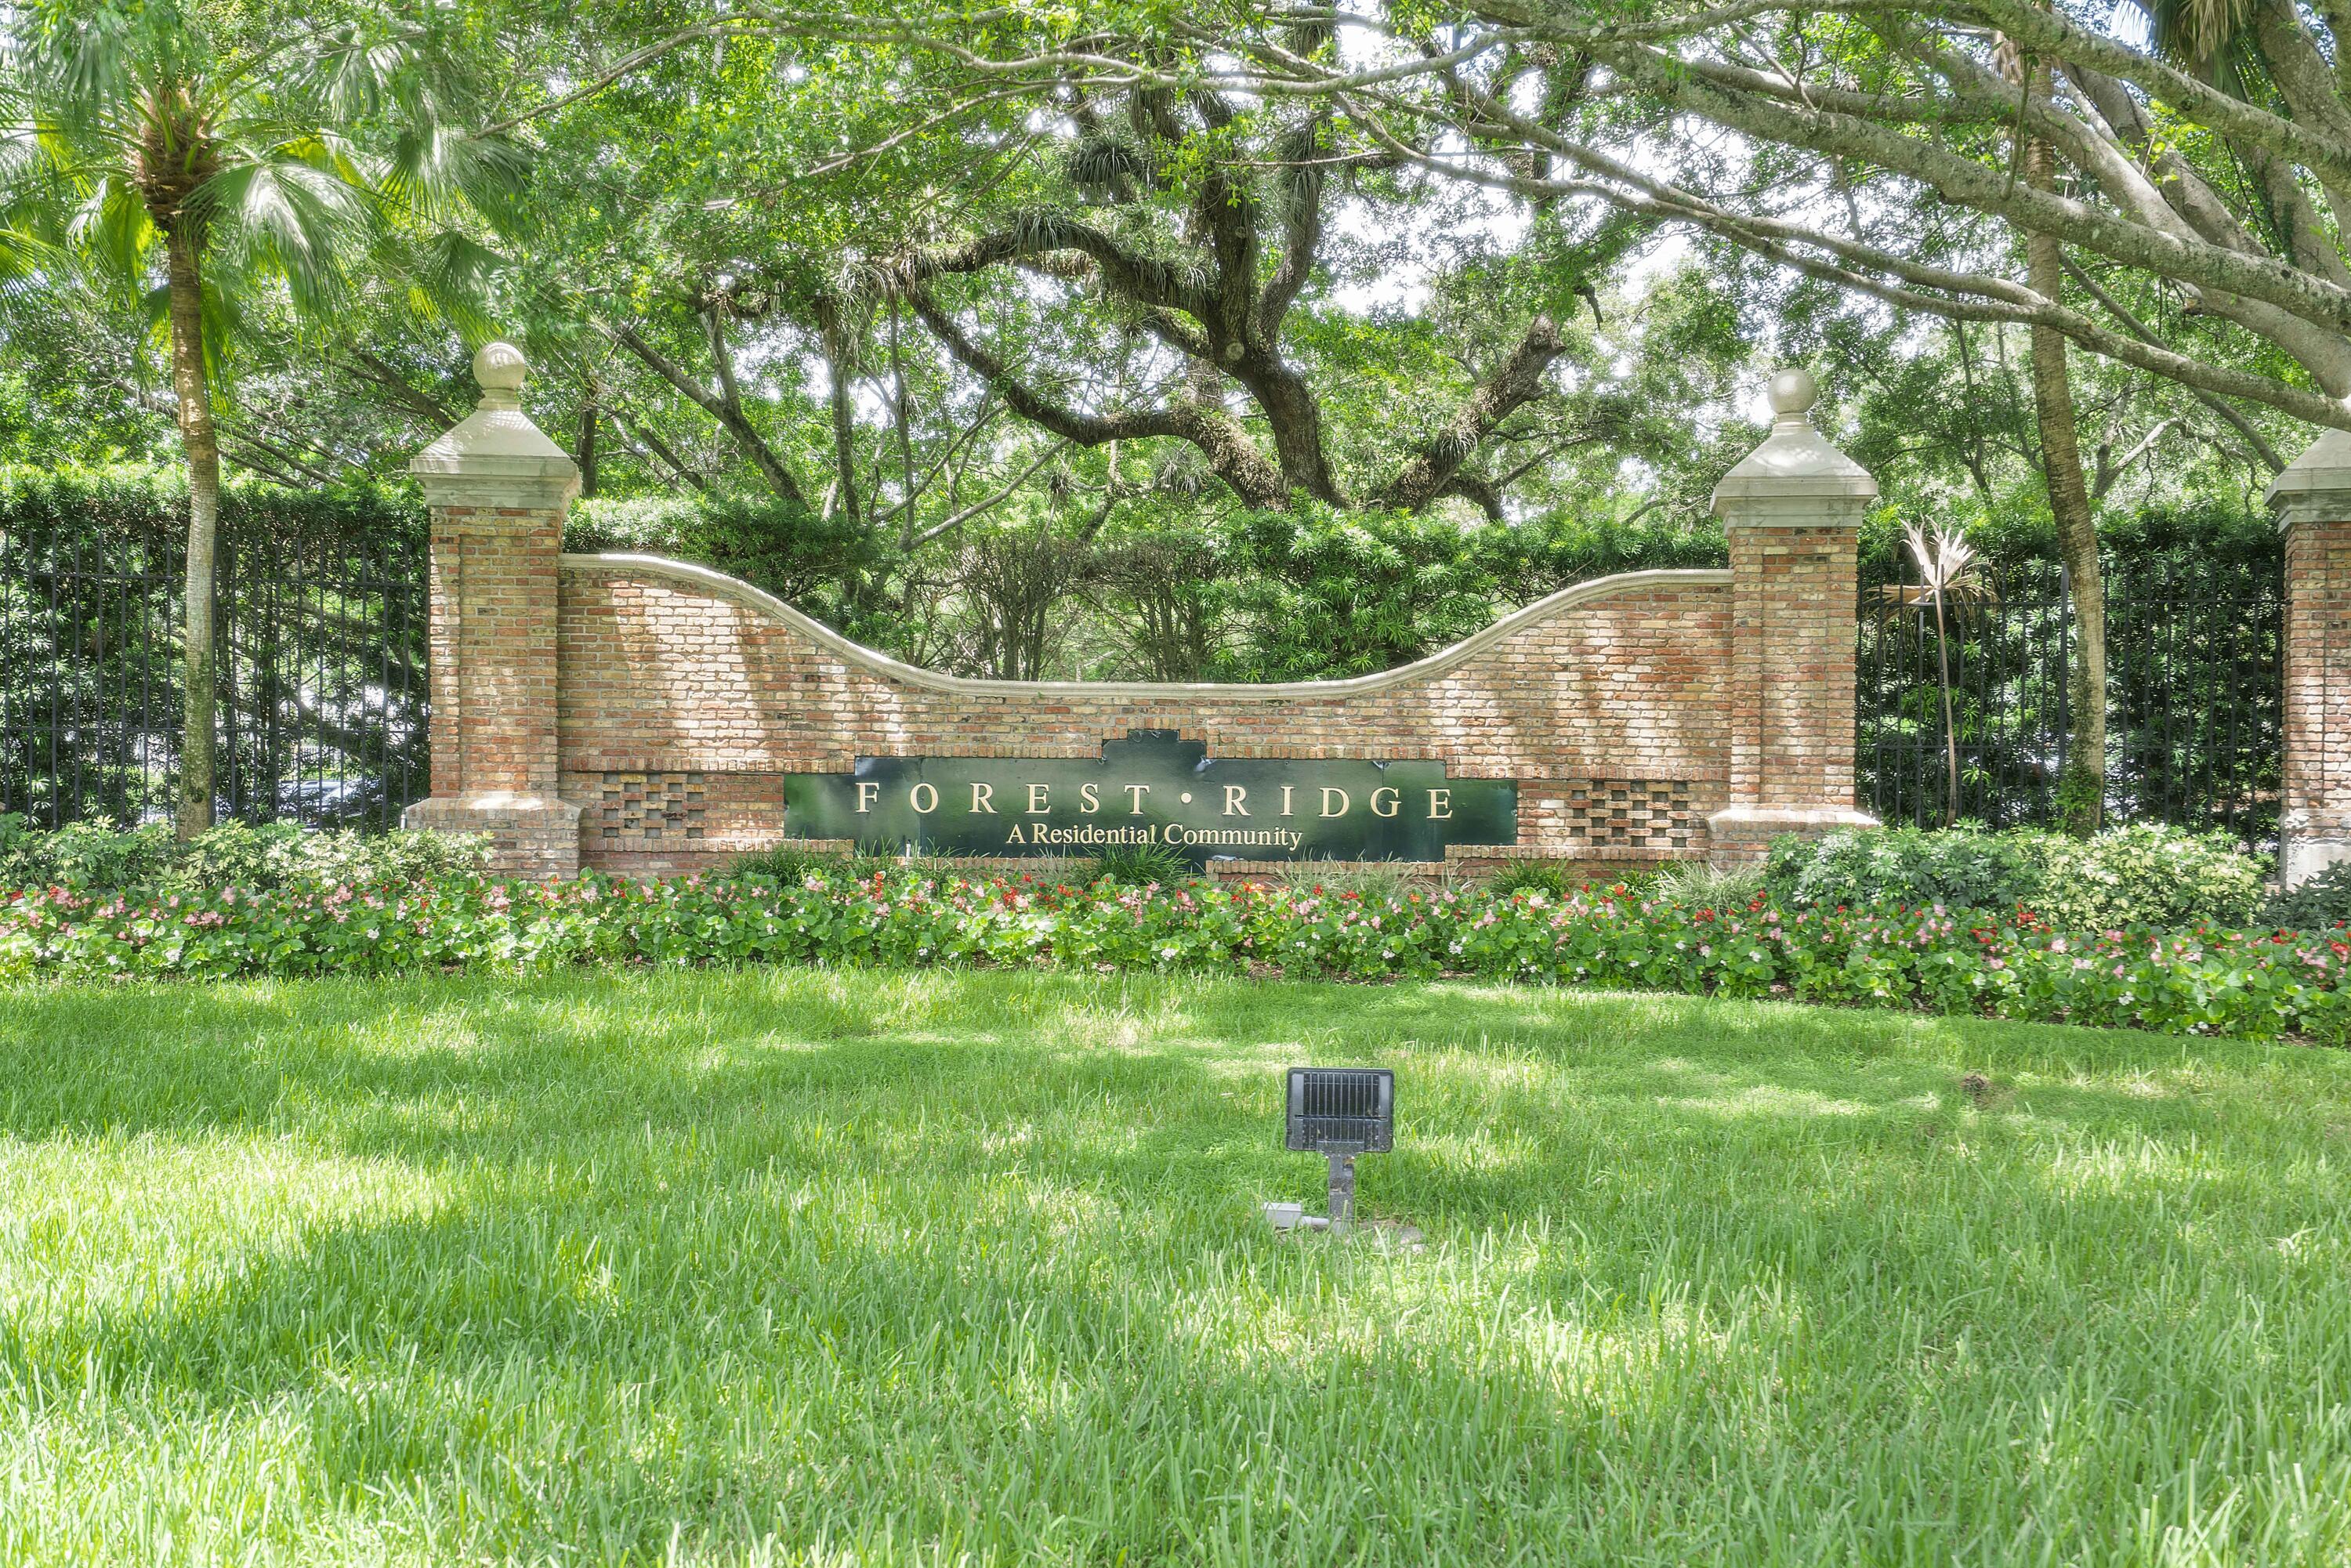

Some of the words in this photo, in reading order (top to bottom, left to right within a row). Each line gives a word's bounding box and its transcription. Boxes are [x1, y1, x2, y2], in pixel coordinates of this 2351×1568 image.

[855, 782, 1150, 815] FOREST
[1222, 784, 1454, 819] RIDGE
[1005, 824, 1027, 844] A
[1031, 823, 1157, 845] Residential
[1164, 823, 1303, 852] Community
